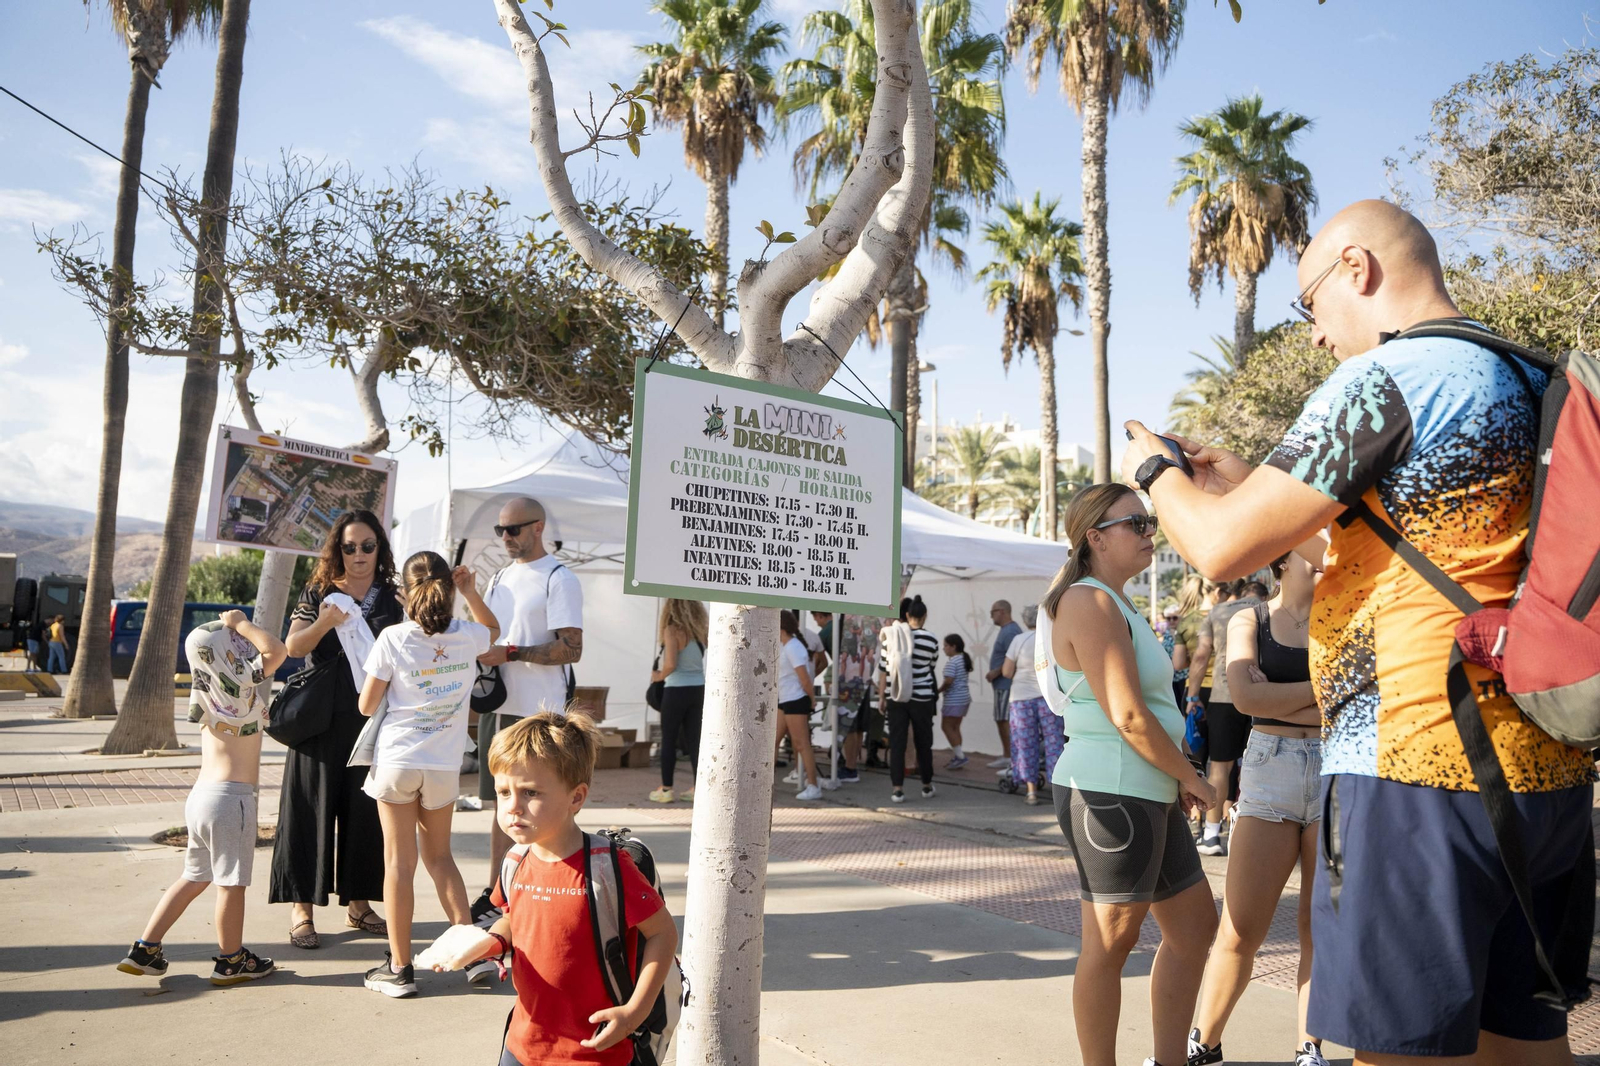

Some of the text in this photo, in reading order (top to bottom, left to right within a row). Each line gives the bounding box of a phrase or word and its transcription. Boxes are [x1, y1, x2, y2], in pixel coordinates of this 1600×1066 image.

[734, 403, 832, 440] LA MINI
[284, 440, 350, 462] MINIDESÉRTICA
[733, 428, 847, 466] DESÉRTICA
[684, 446, 862, 487] ENTRADA CAJONES DE SALIDA
[670, 460, 872, 504] CATEGORÍAS / HORARIOS
[686, 483, 769, 507] CHUPETINES:
[775, 496, 800, 511] 17.15
[816, 502, 842, 517] 17.30
[846, 507, 857, 519] H.
[671, 497, 780, 524] PREBENJAMINES:
[786, 514, 813, 528] 17.30
[827, 520, 853, 534] 17.45
[857, 524, 869, 536] H.
[682, 516, 766, 538] BENJAMINES:
[772, 528, 799, 543] 17.45
[814, 533, 843, 548] 18.00
[847, 538, 858, 550] H.
[691, 534, 756, 554] ALEVINES:
[762, 543, 792, 557] 18.00
[807, 548, 834, 563] 18.15
[838, 552, 850, 564] H.
[684, 550, 762, 571] INFANTILES:
[768, 560, 795, 574] 18.15
[811, 564, 839, 579] 18.30
[843, 568, 855, 580] H.
[691, 567, 751, 586] CADETES:
[757, 575, 788, 589] 18.30
[803, 579, 831, 594] 18.45
[835, 583, 847, 595] H.
[421, 662, 469, 676] MINIDESÉRTICA
[426, 680, 463, 696] aqualia
[1477, 679, 1508, 699] TR
[513, 882, 588, 896] OMMY HILFIGER
